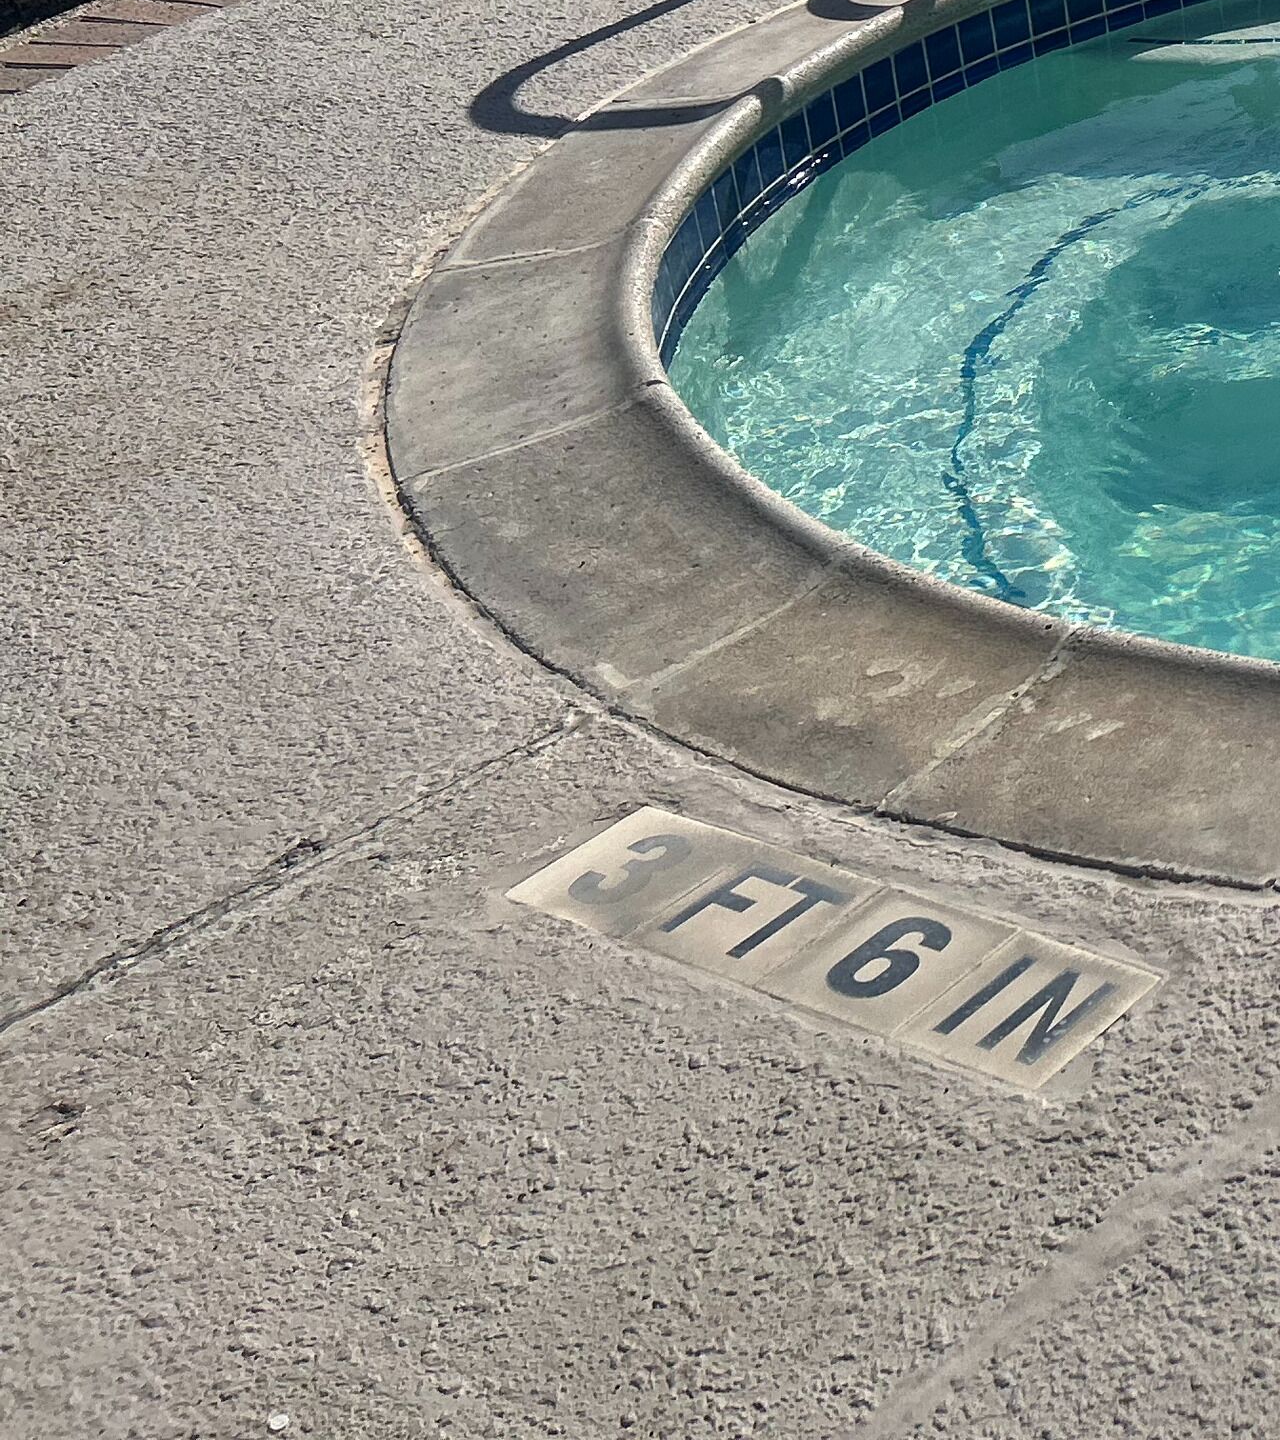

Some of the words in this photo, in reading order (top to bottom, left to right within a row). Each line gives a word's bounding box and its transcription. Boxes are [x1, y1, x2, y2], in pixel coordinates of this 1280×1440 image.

[567, 834, 692, 904] 3
[662, 866, 853, 960] FT
[825, 915, 952, 998] 6
[932, 954, 1120, 1066] IN
